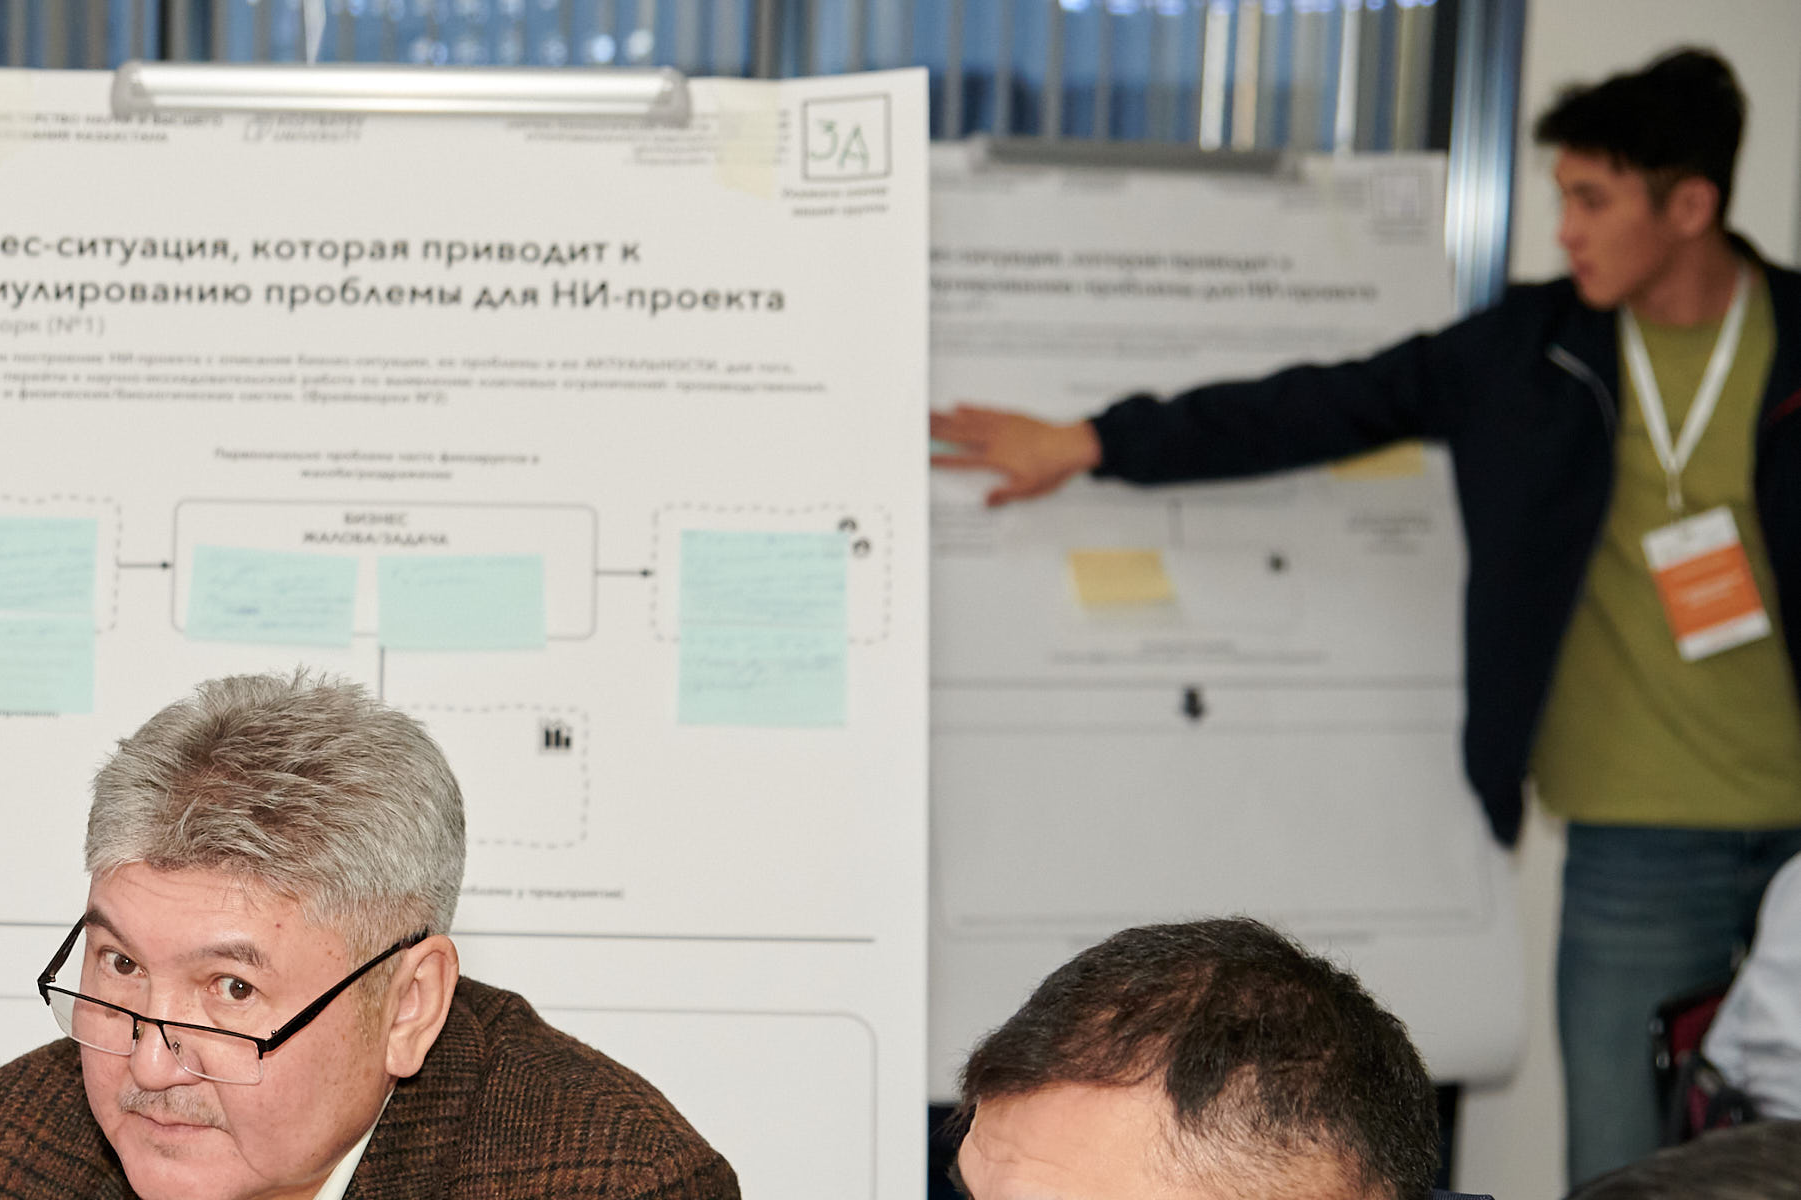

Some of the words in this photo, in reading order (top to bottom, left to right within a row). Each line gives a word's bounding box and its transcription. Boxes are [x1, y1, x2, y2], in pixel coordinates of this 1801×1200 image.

[252, 236, 410, 268] которая
[422, 238, 609, 269] приводит
[620, 240, 642, 264] к
[265, 274, 464, 312] проблемы
[474, 284, 539, 311] для
[551, 281, 787, 318] НИ-проекта
